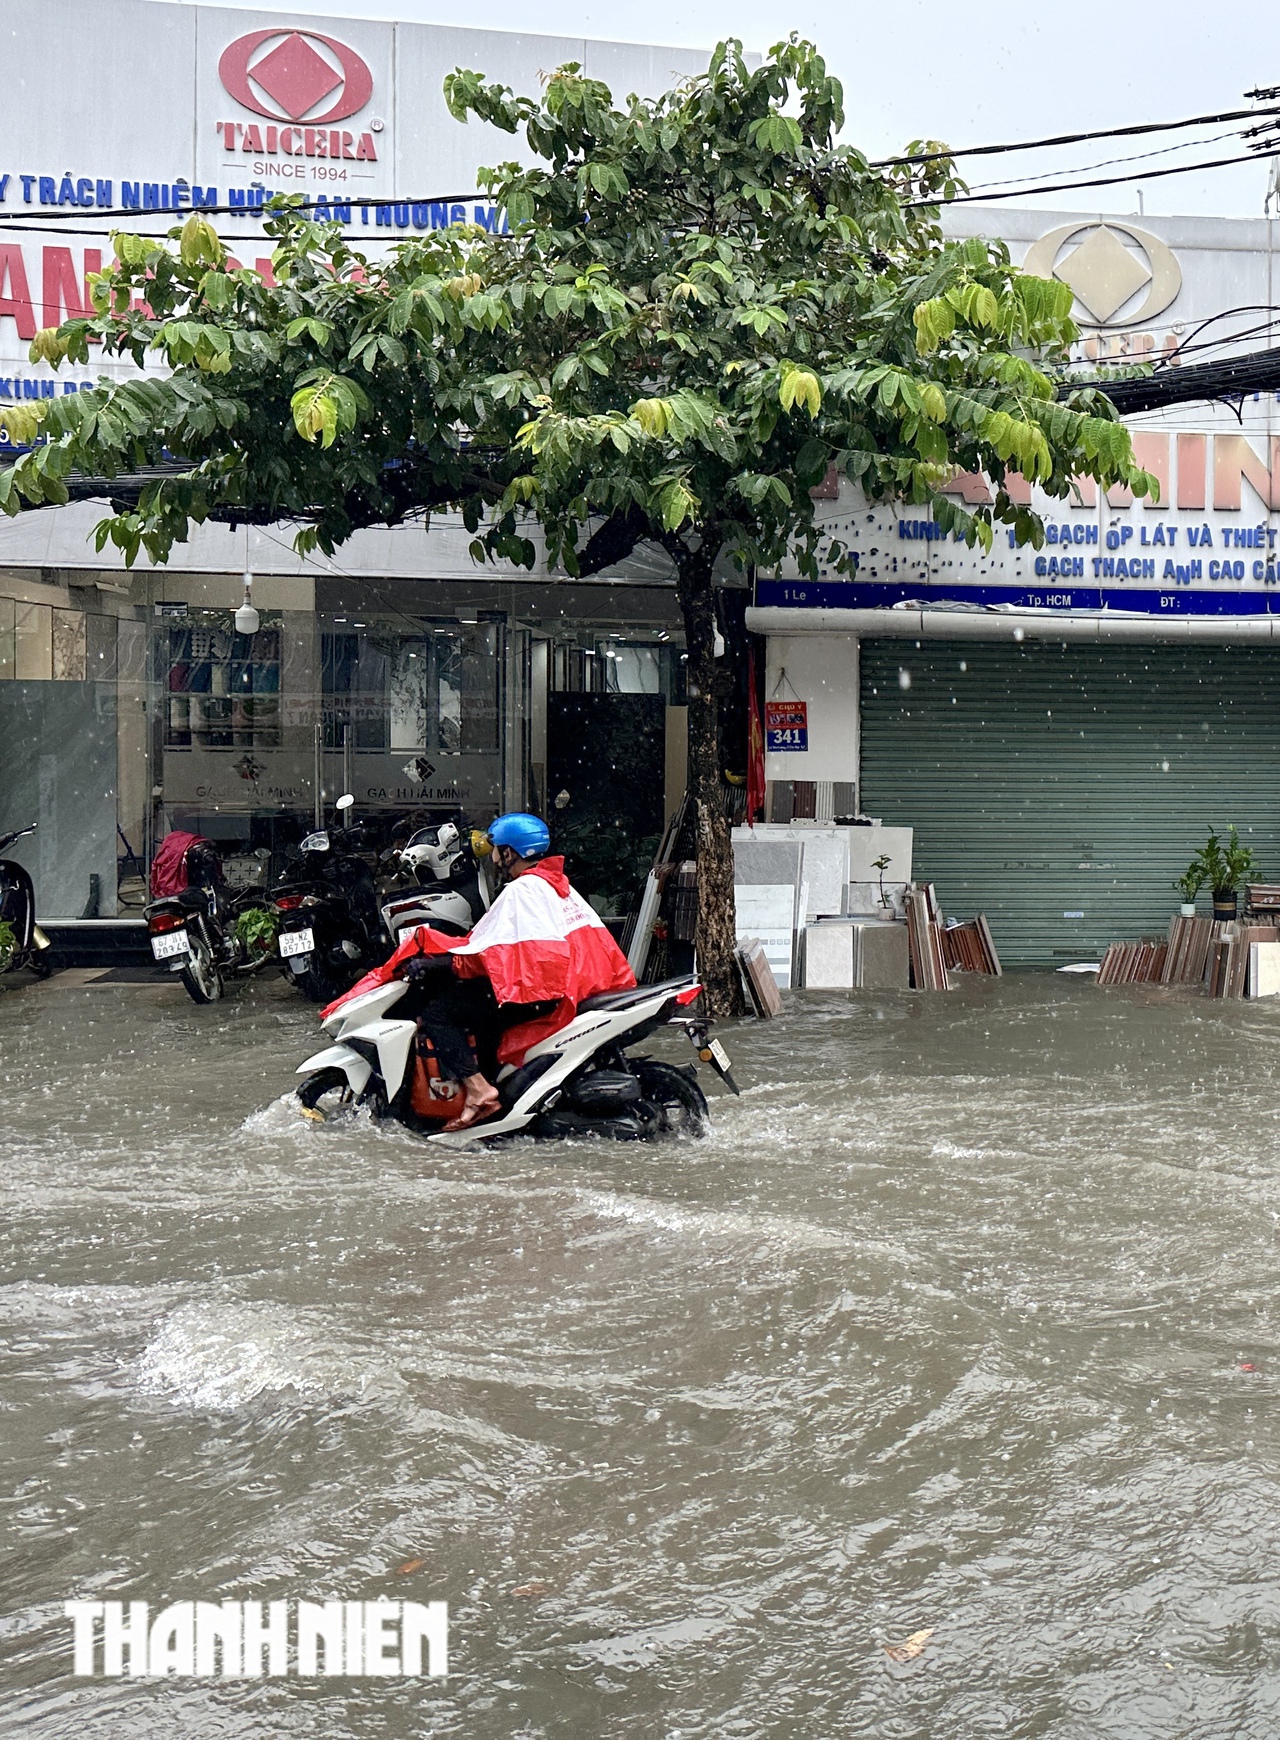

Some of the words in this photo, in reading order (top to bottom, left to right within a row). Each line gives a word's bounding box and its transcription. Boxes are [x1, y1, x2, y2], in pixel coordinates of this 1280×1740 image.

[216, 122, 378, 161] TAICERA
[253, 161, 305, 178] SINCE
[310, 167, 348, 181] 1994
[20, 171, 113, 208] TRÁCH
[121, 178, 218, 219] NHIỆM
[0, 377, 55, 399] KINH
[1046, 523, 1099, 549] GẠCH
[1106, 517, 1133, 550] ỐP
[1141, 522, 1178, 547] LÁT
[1187, 523, 1213, 547] VÀ
[1221, 521, 1277, 548] THIẾT
[1035, 556, 1084, 582] GẠCH
[1092, 557, 1155, 582] THẠCH
[1209, 560, 1245, 580] CAO
[1046, 594, 1072, 606] HCM
[773, 729, 802, 744] 341
[436, 787, 470, 800] MINH
[379, 1024, 403, 1036] HONDA
[555, 1026, 596, 1048] VARIO
